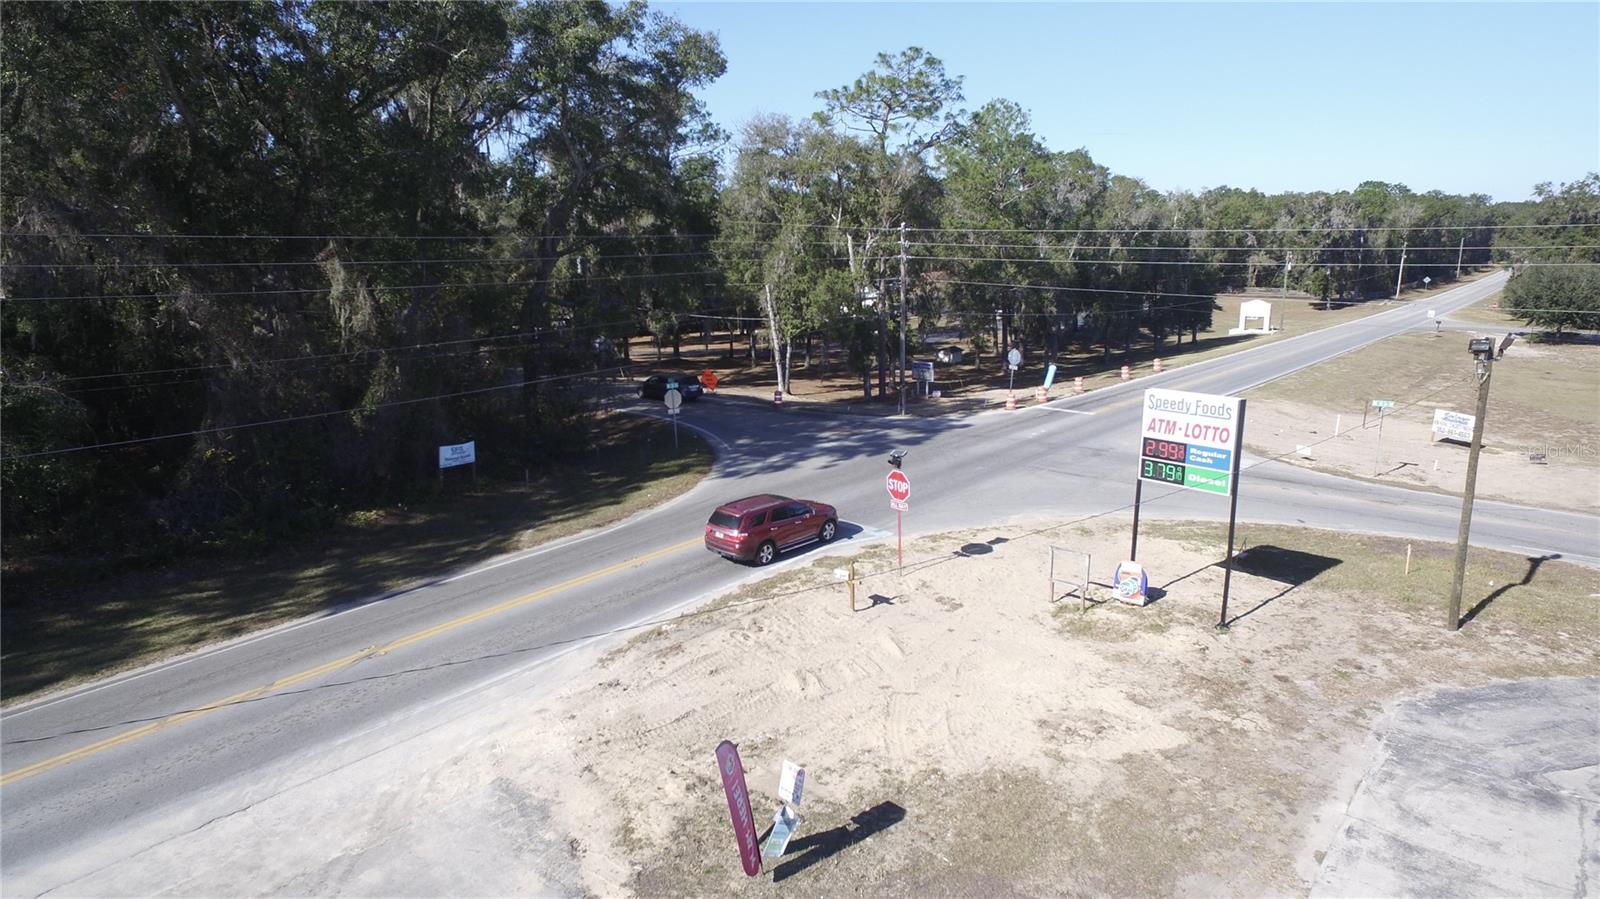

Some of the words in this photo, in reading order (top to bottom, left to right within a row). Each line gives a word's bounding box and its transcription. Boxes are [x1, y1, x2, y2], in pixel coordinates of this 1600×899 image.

[1148, 394, 1191, 414] Speedy
[1194, 400, 1232, 420] Foods
[1147, 418, 1176, 436] ATM
[1183, 423, 1230, 443] LOTTO
[1189, 448, 1227, 459] Regular
[1189, 456, 1213, 464] Cash
[889, 478, 908, 493] STOP
[1188, 473, 1226, 487] Diesel
